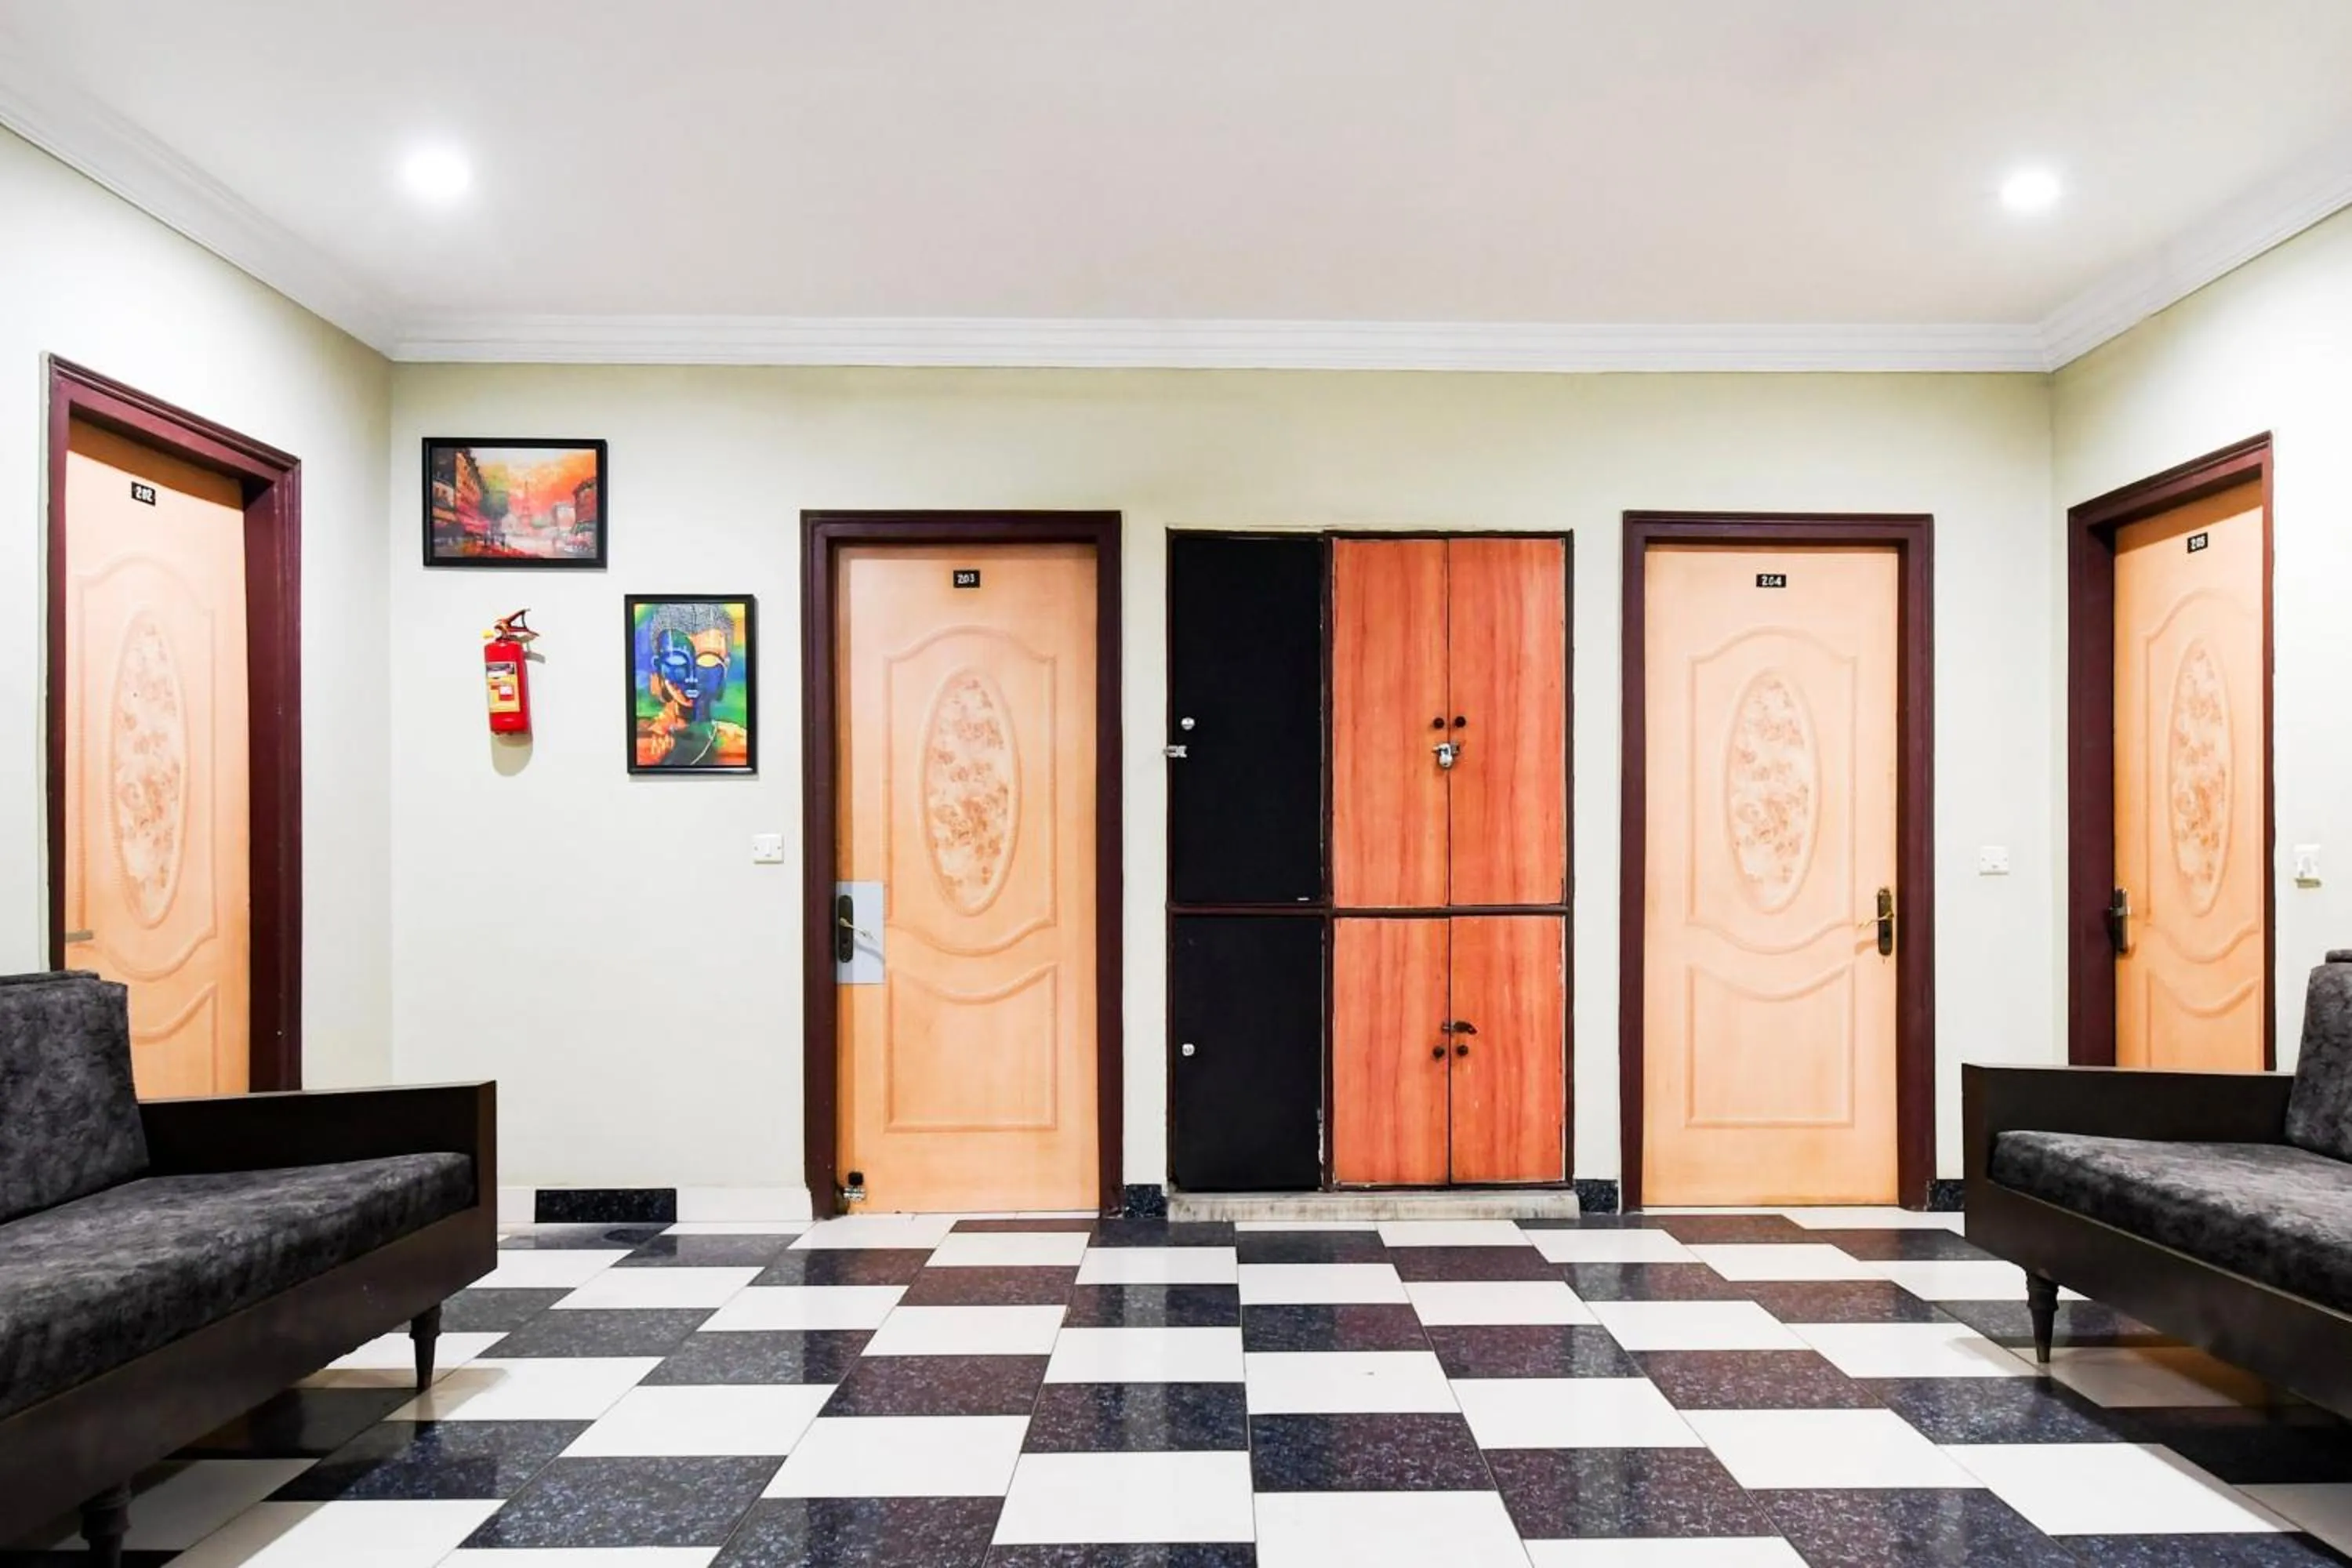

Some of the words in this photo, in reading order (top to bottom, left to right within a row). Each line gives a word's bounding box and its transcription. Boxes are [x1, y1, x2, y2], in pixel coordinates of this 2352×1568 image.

[136, 485, 153, 502] 202
[956, 573, 975, 584] 203
[1762, 575, 1782, 586] 204
